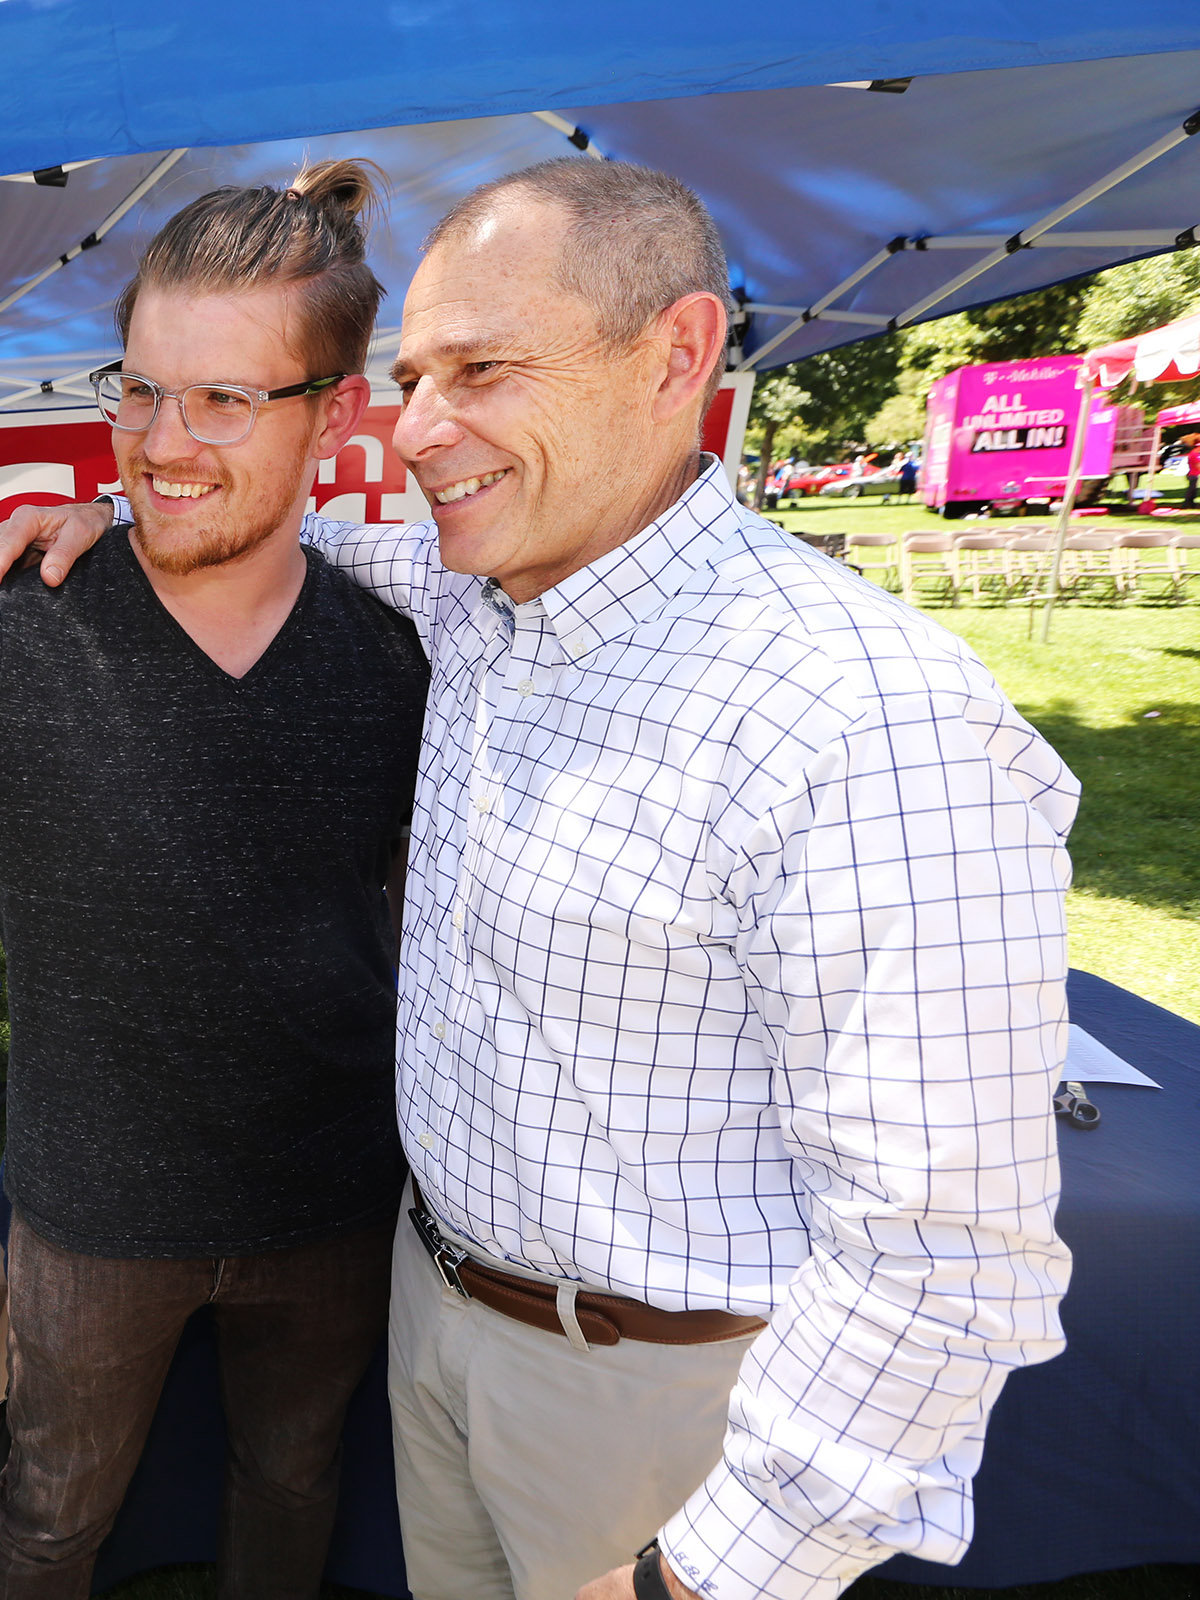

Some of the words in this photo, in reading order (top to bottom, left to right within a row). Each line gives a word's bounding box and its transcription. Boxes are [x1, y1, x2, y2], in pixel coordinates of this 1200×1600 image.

[981, 393, 1028, 414] ALL
[973, 428, 1024, 452] ALL
[1026, 426, 1064, 448] IN!
